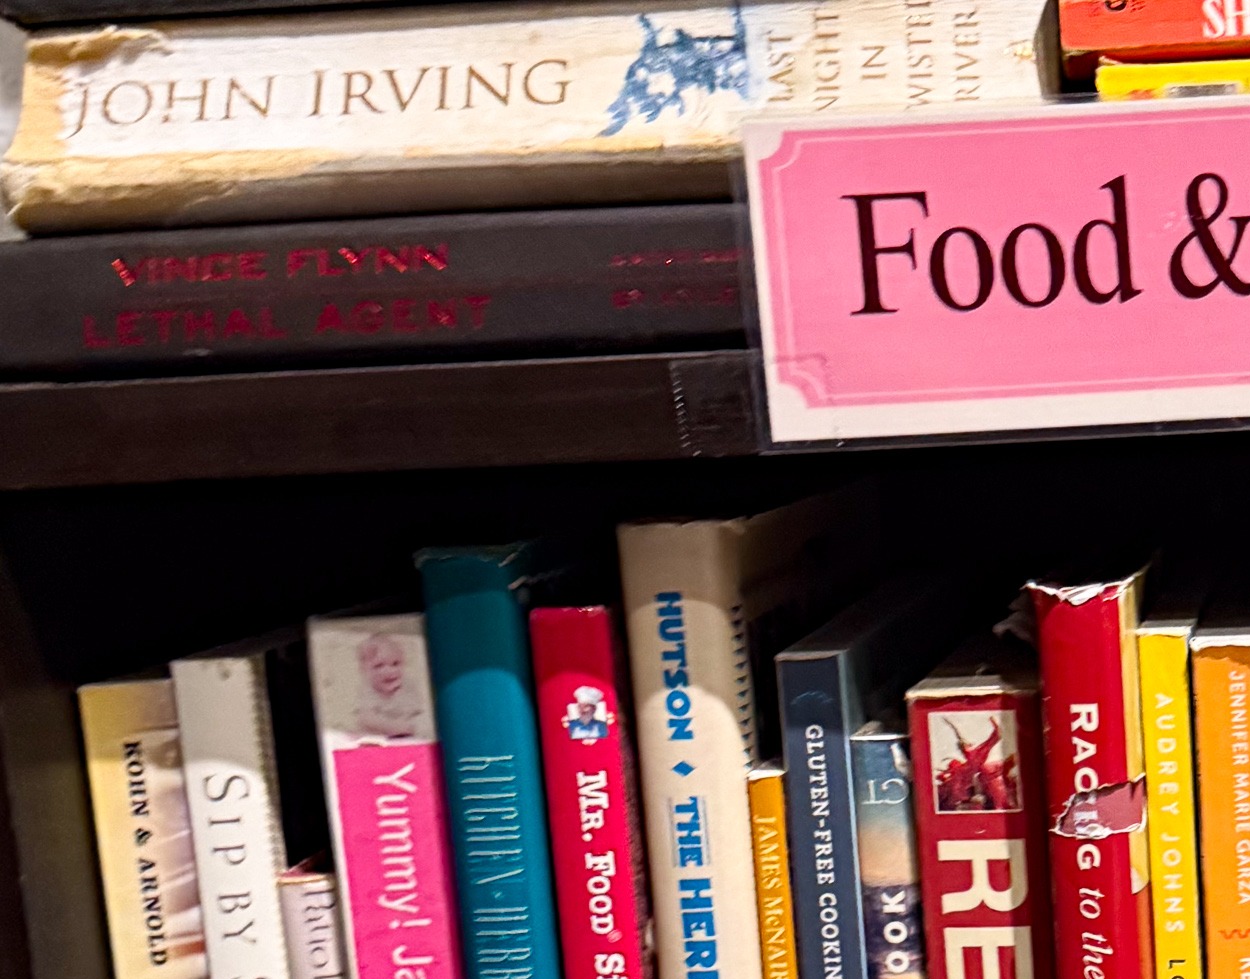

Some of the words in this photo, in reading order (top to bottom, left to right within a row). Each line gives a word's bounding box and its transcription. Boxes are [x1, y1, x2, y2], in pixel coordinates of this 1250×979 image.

[69, 75, 275, 138] JOHN
[308, 58, 572, 118] IRVING
[768, 30, 795, 102] LAST
[860, 44, 886, 80] IN
[955, 8, 980, 102] RIVER
[110, 249, 268, 288] VINCE
[286, 243, 451, 278] FLYNN
[842, 175, 1141, 316] Food
[82, 302, 290, 350] LETHAL
[314, 296, 492, 336] AGENT
[655, 591, 699, 742] HUTSON
[1154, 693, 1181, 816] AUDREY
[1227, 670, 1250, 766] JENNIFER
[203, 771, 250, 868] SIP
[373, 761, 432, 930] Yummy!
[674, 796, 705, 869] THE
[804, 723, 835, 885] GLUTEN-FREE
[123, 740, 149, 818] KOHN
[136, 857, 169, 967] ARNOLD
[752, 814, 779, 890] JAMES
[1160, 832, 1186, 934] JOHNS
[217, 889, 257, 947] BY
[1078, 887, 1106, 920] to
